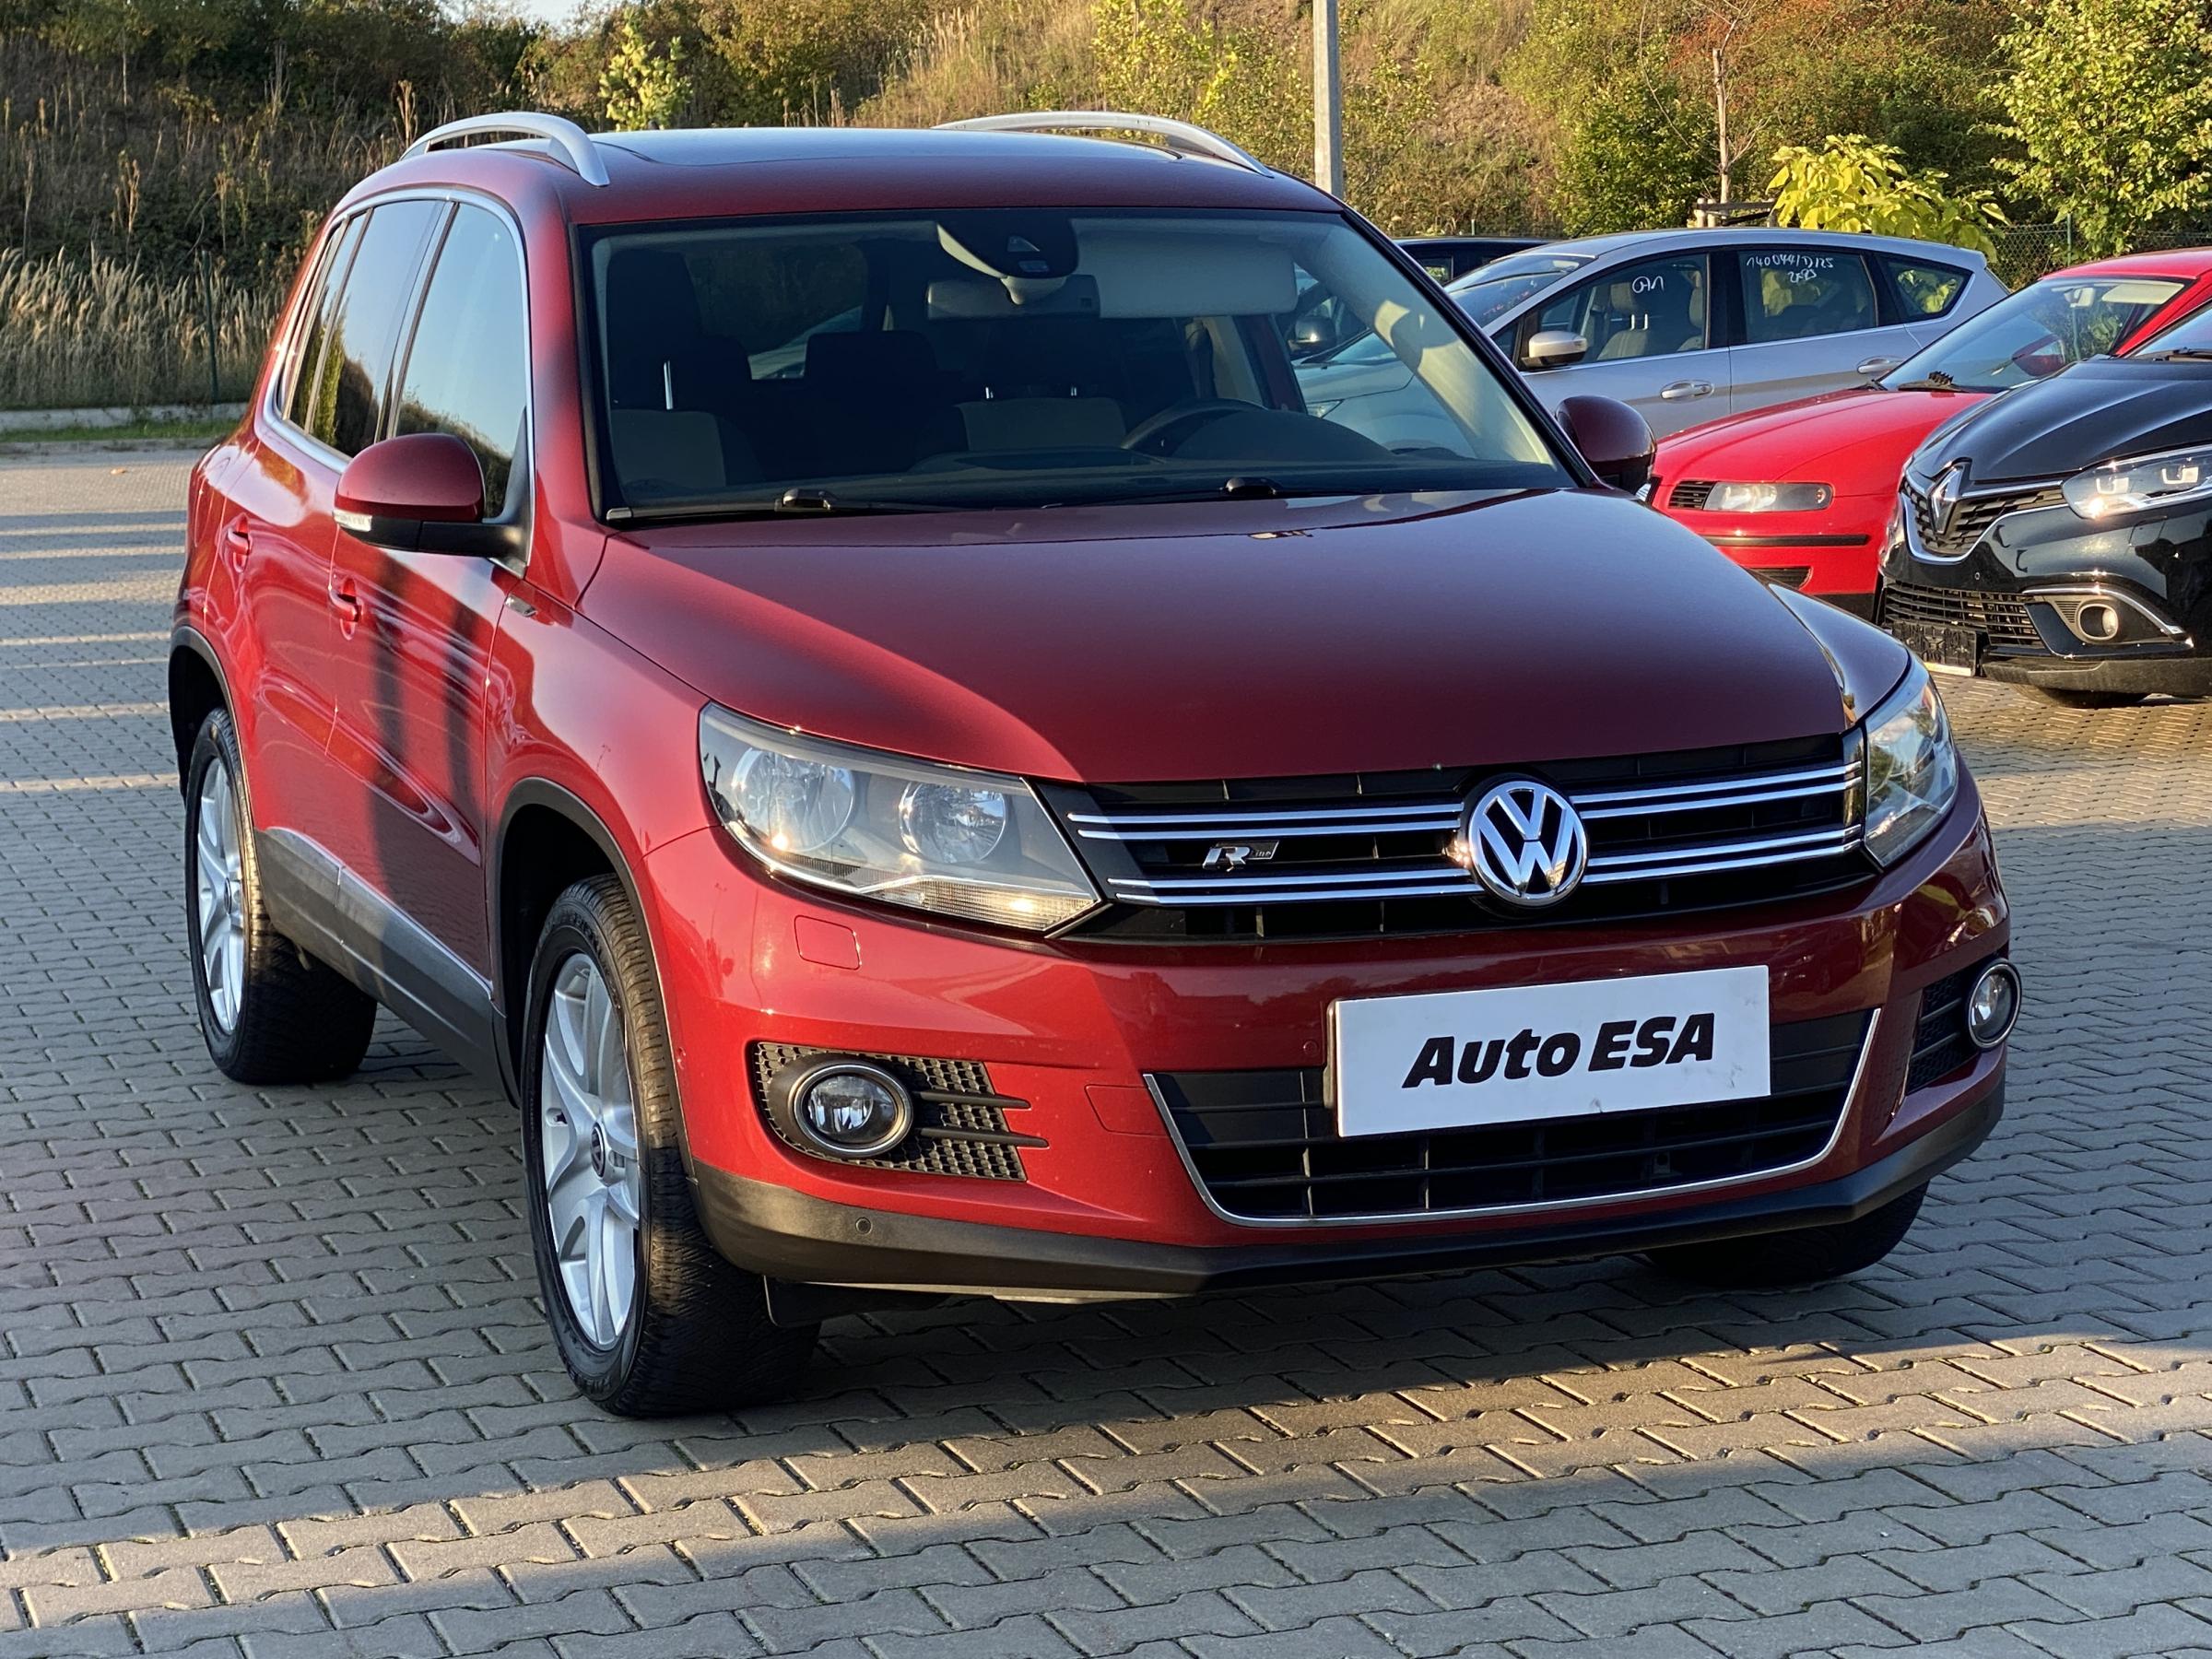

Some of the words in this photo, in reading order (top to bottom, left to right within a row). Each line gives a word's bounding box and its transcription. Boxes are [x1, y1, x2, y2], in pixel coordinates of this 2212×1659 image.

[1202, 846, 1250, 871] R
[1473, 783, 1583, 902] VW
[1402, 1029, 1581, 1088] Auto
[1588, 1013, 1715, 1072] ESA
